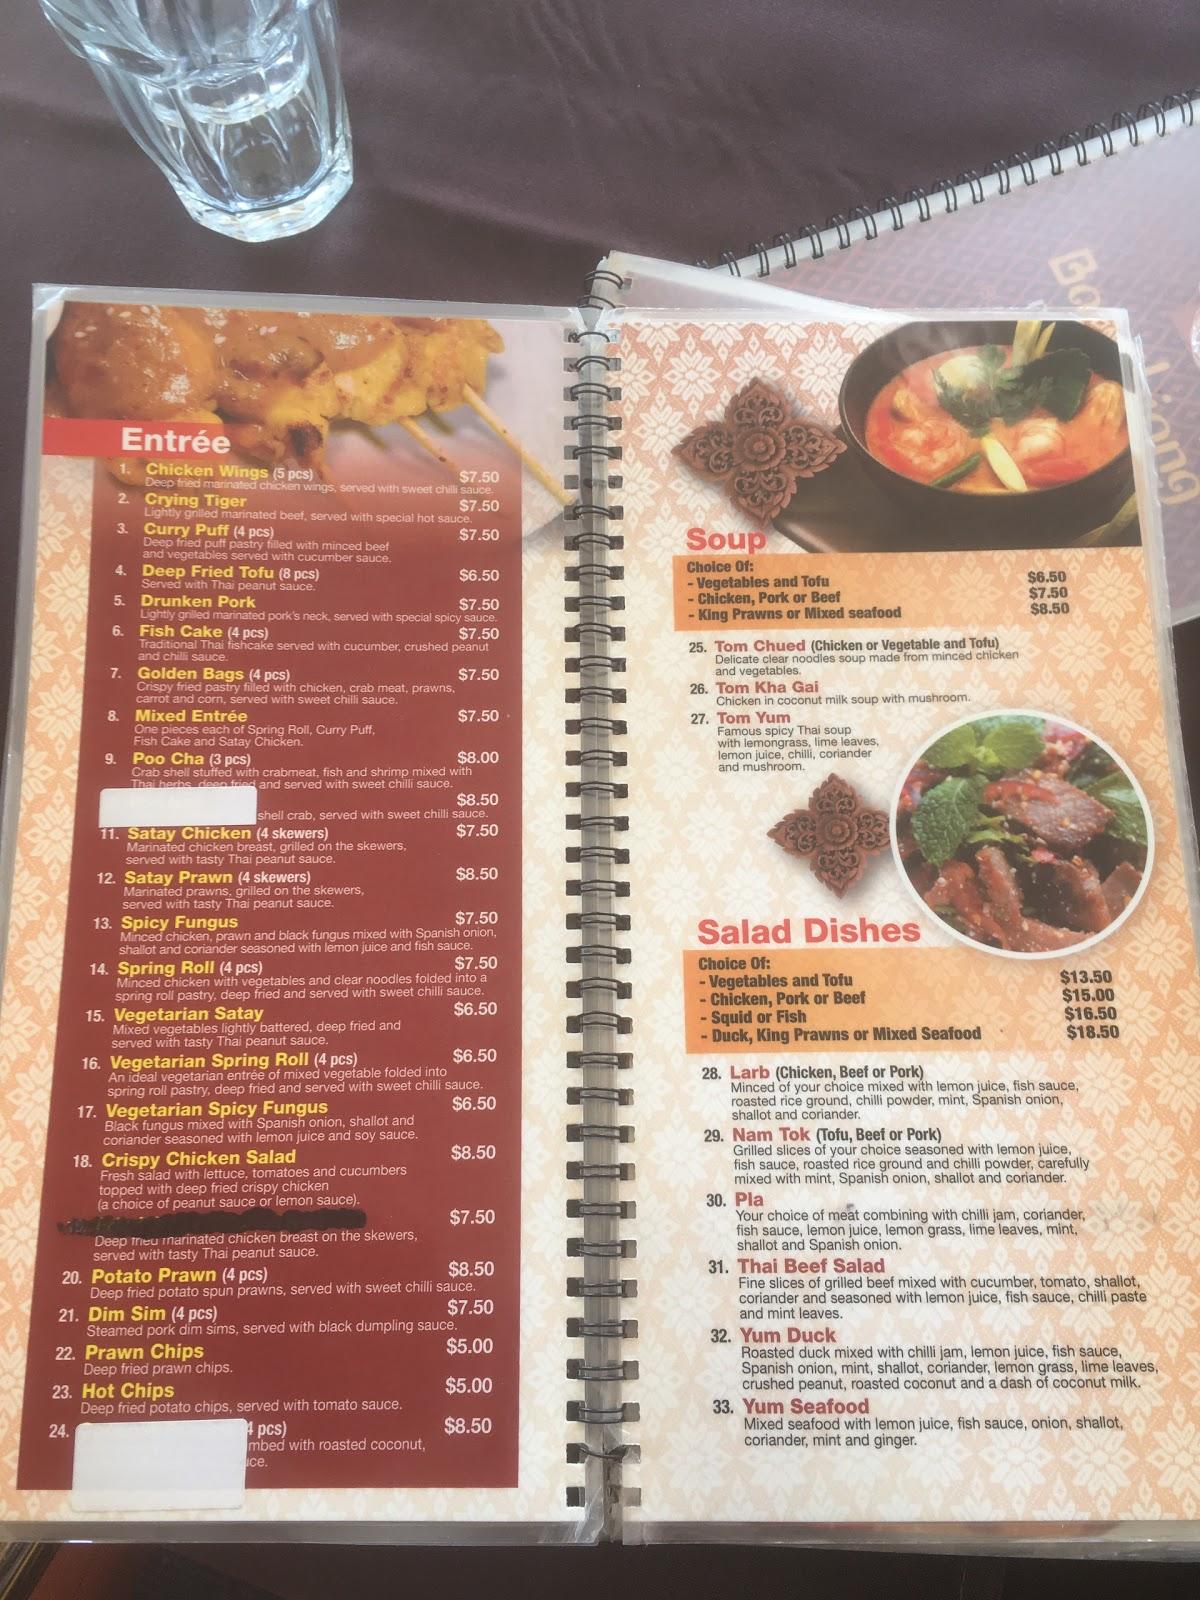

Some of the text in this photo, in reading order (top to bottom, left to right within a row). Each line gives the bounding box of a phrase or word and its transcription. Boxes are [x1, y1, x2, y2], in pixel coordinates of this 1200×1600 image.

[120, 426, 231, 454] Entrée
[119, 462, 313, 482] 1. Chicken Wings (5 pcs)
[458, 469, 500, 485] $7.50
[117, 492, 247, 510] 2. Crying Tiger
[458, 498, 500, 514] $7.50
[144, 507, 473, 525] Lightly grilled marinated beef, served with special hot sauce.
[117, 522, 275, 541] 3. Curry Puff (4 pcs)
[458, 527, 500, 543] $7.50
[686, 528, 767, 554] Soup
[115, 564, 320, 583] 4. Deep Fried Tofu (8 pcs)
[458, 568, 500, 583] $6.50
[687, 559, 754, 575] Choice Of:
[1027, 571, 1067, 584] $6.50
[114, 594, 257, 609] 5. Drunken Pork
[1028, 586, 1069, 600] $7.50
[458, 597, 500, 613] $7.50
[1030, 602, 1070, 616] $8.50
[698, 606, 902, 623] King Prawns or Mixed seafood
[689, 636, 1000, 654] 25. Tom Chued (Chicken or Vegetable and Tofu)
[690, 680, 819, 696] 26. Tom Kha Gai
[108, 708, 248, 723] 8. Mixed Entrée
[457, 709, 500, 724] $7.50
[691, 712, 791, 726] 27. Tom Yum
[134, 723, 376, 737] One pieces each of Spring Roll, Curry Puff,
[97, 870, 311, 887] 12. Satay Prawn (4 skewers)
[455, 866, 499, 882] $8.50
[93, 914, 239, 931] 13. Spicy Fungus
[455, 910, 499, 926] $7.50
[698, 917, 921, 945] Salad Dishes
[1060, 969, 1113, 986] $13.50
[1062, 987, 1115, 1004] $15.00
[85, 1006, 264, 1024] 15. Vegetarian Satay
[453, 1001, 498, 1018] $6.50
[1064, 1006, 1118, 1022] $16.50
[1066, 1024, 1120, 1040] $18.50
[701, 1065, 924, 1082] 28. Larb (Chicken, Beef or Pork)
[77, 1100, 329, 1120] 17. Vegetarian Spicy Fungus
[452, 1096, 497, 1113] $6.50
[704, 1127, 942, 1145] 29. Nam Tok (Tofu, Beef or Pork)
[73, 1149, 297, 1171] 18. Crispy Chicken Salad
[451, 1144, 497, 1161] $8.50
[706, 1192, 764, 1208] 30. Pla
[708, 1257, 885, 1275] 31. Thai Beef Salad
[58, 1306, 218, 1323] 21. Dim Sim (4 pcs)
[447, 1299, 494, 1317] $7.50
[710, 1327, 837, 1344] 32. Yum Duck
[55, 1343, 205, 1362] 22. Prawn Chips
[446, 1337, 493, 1355] $5.00
[52, 1383, 175, 1401] 23. Hot Chips
[445, 1377, 493, 1395] $5.00
[712, 1398, 870, 1415] 33. Yum Seafood
[744, 1433, 918, 1449] coriander, mint and ginger.
